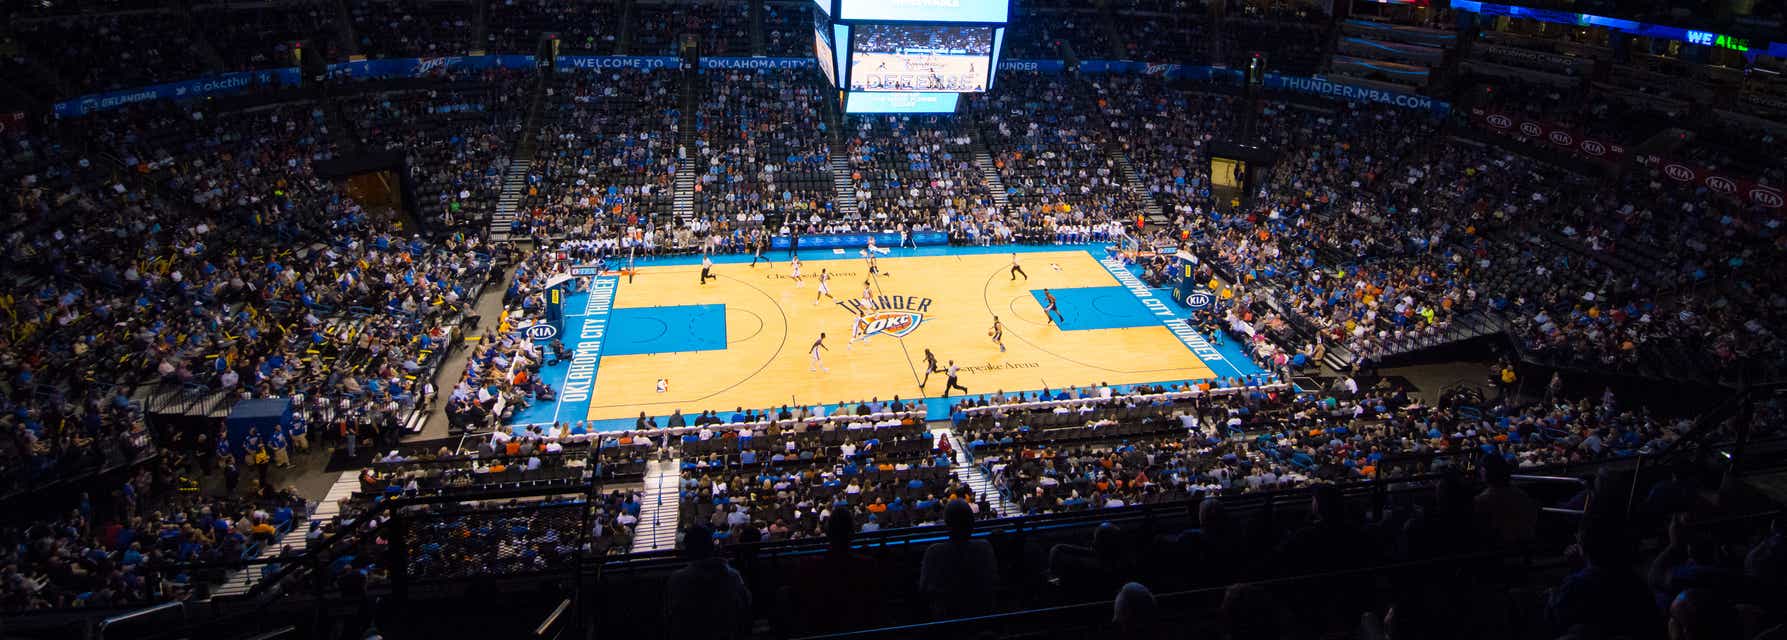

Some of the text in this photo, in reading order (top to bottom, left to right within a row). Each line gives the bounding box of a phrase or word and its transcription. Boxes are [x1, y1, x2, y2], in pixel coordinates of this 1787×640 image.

[1687, 29, 1713, 46] WE
[573, 58, 641, 68] WELCOME
[645, 58, 664, 68] TO
[708, 58, 777, 69] OKLAHOMA
[779, 59, 807, 69] CITY
[1000, 61, 1040, 72] UNDER
[1280, 76, 1432, 109] THUNDER.NBA.COM
[865, 315, 909, 334] OKC
[1142, 298, 1176, 316] CITY
[1163, 319, 1222, 360] THUNDER
[562, 278, 617, 402] OKLAHOMA CITY THUNDER
[1006, 360, 1041, 371] Arena
